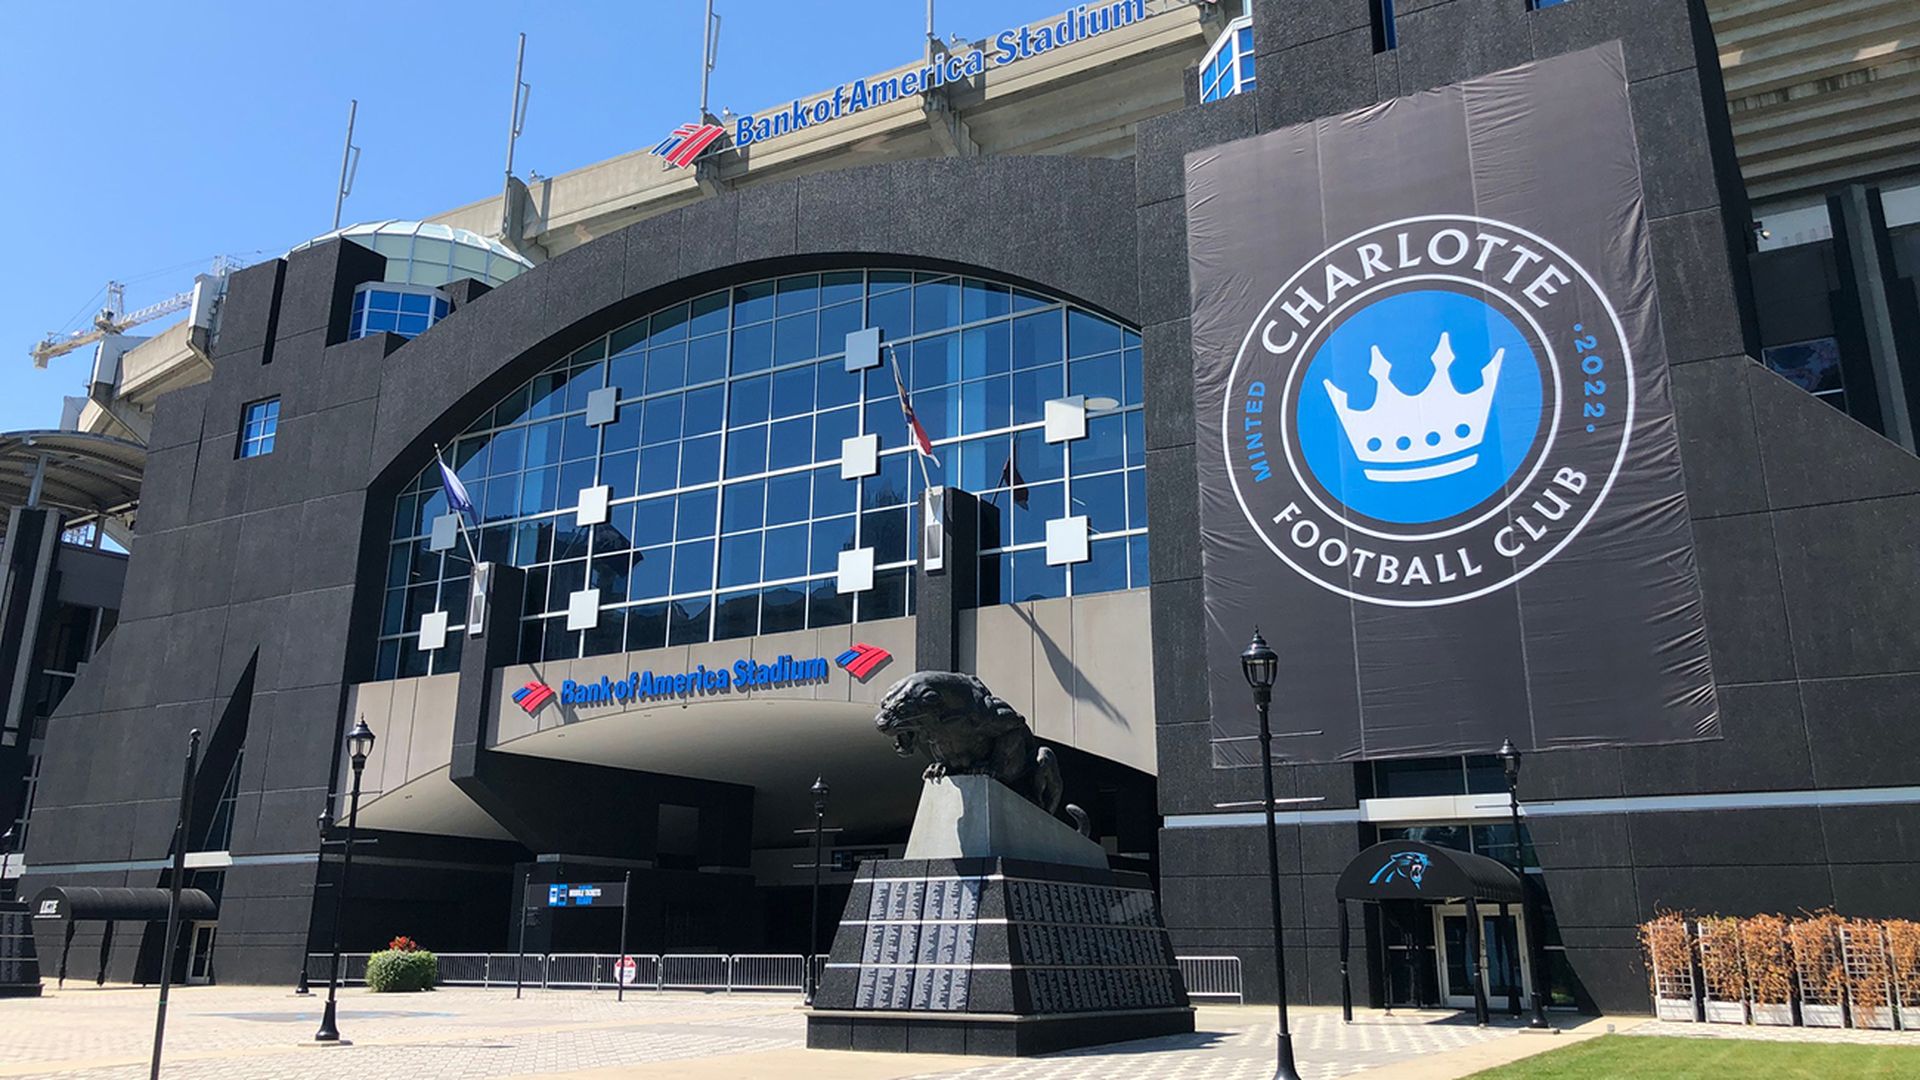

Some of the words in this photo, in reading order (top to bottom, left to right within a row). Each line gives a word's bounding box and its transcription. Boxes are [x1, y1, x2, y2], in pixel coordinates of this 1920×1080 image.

[734, 99, 811, 148] Bank
[812, 84, 848, 124] of
[849, 49, 985, 114] America
[994, 0, 1147, 66] Stadium
[1261, 228, 1571, 355] CHARLOTTE
[1244, 380, 1273, 484] MINTED
[1272, 501, 1483, 586] FOOTBALL
[1493, 465, 1588, 558] CLUB
[561, 675, 614, 705] Bank
[614, 671, 640, 702] of
[638, 664, 730, 700] America
[732, 654, 829, 687] Stadium
